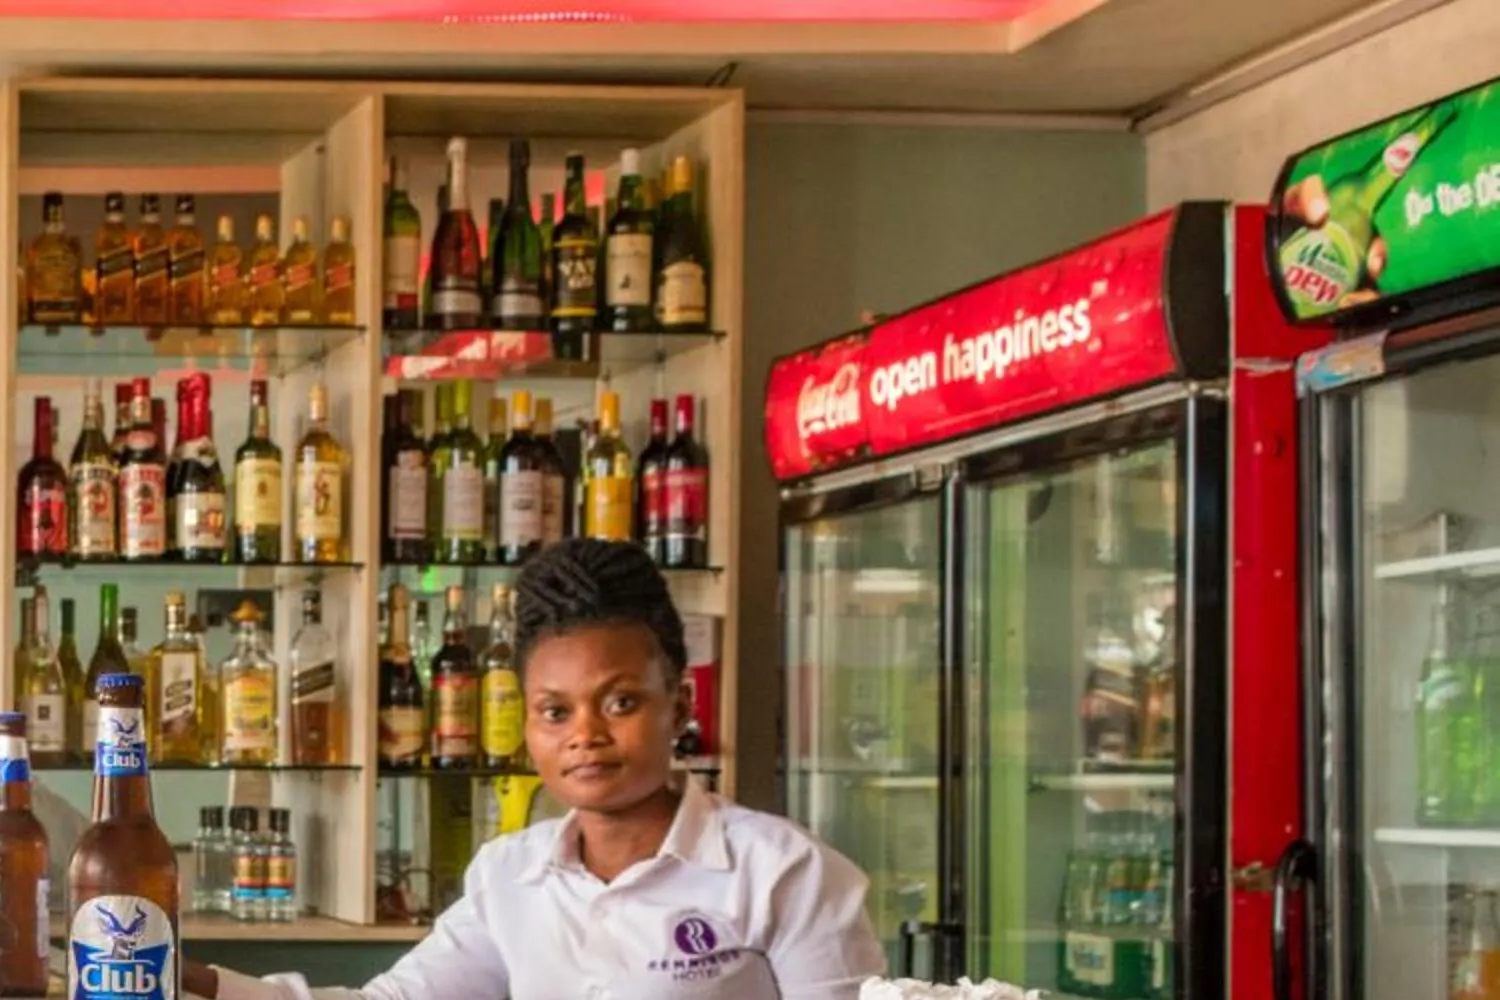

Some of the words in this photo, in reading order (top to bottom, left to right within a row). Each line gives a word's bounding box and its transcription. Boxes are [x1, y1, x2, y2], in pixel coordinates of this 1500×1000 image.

[1436, 182, 1473, 215] the
[869, 350, 937, 411] open
[943, 299, 1092, 384] happiness
[103, 752, 141, 768] Club
[81, 963, 156, 993] Club
